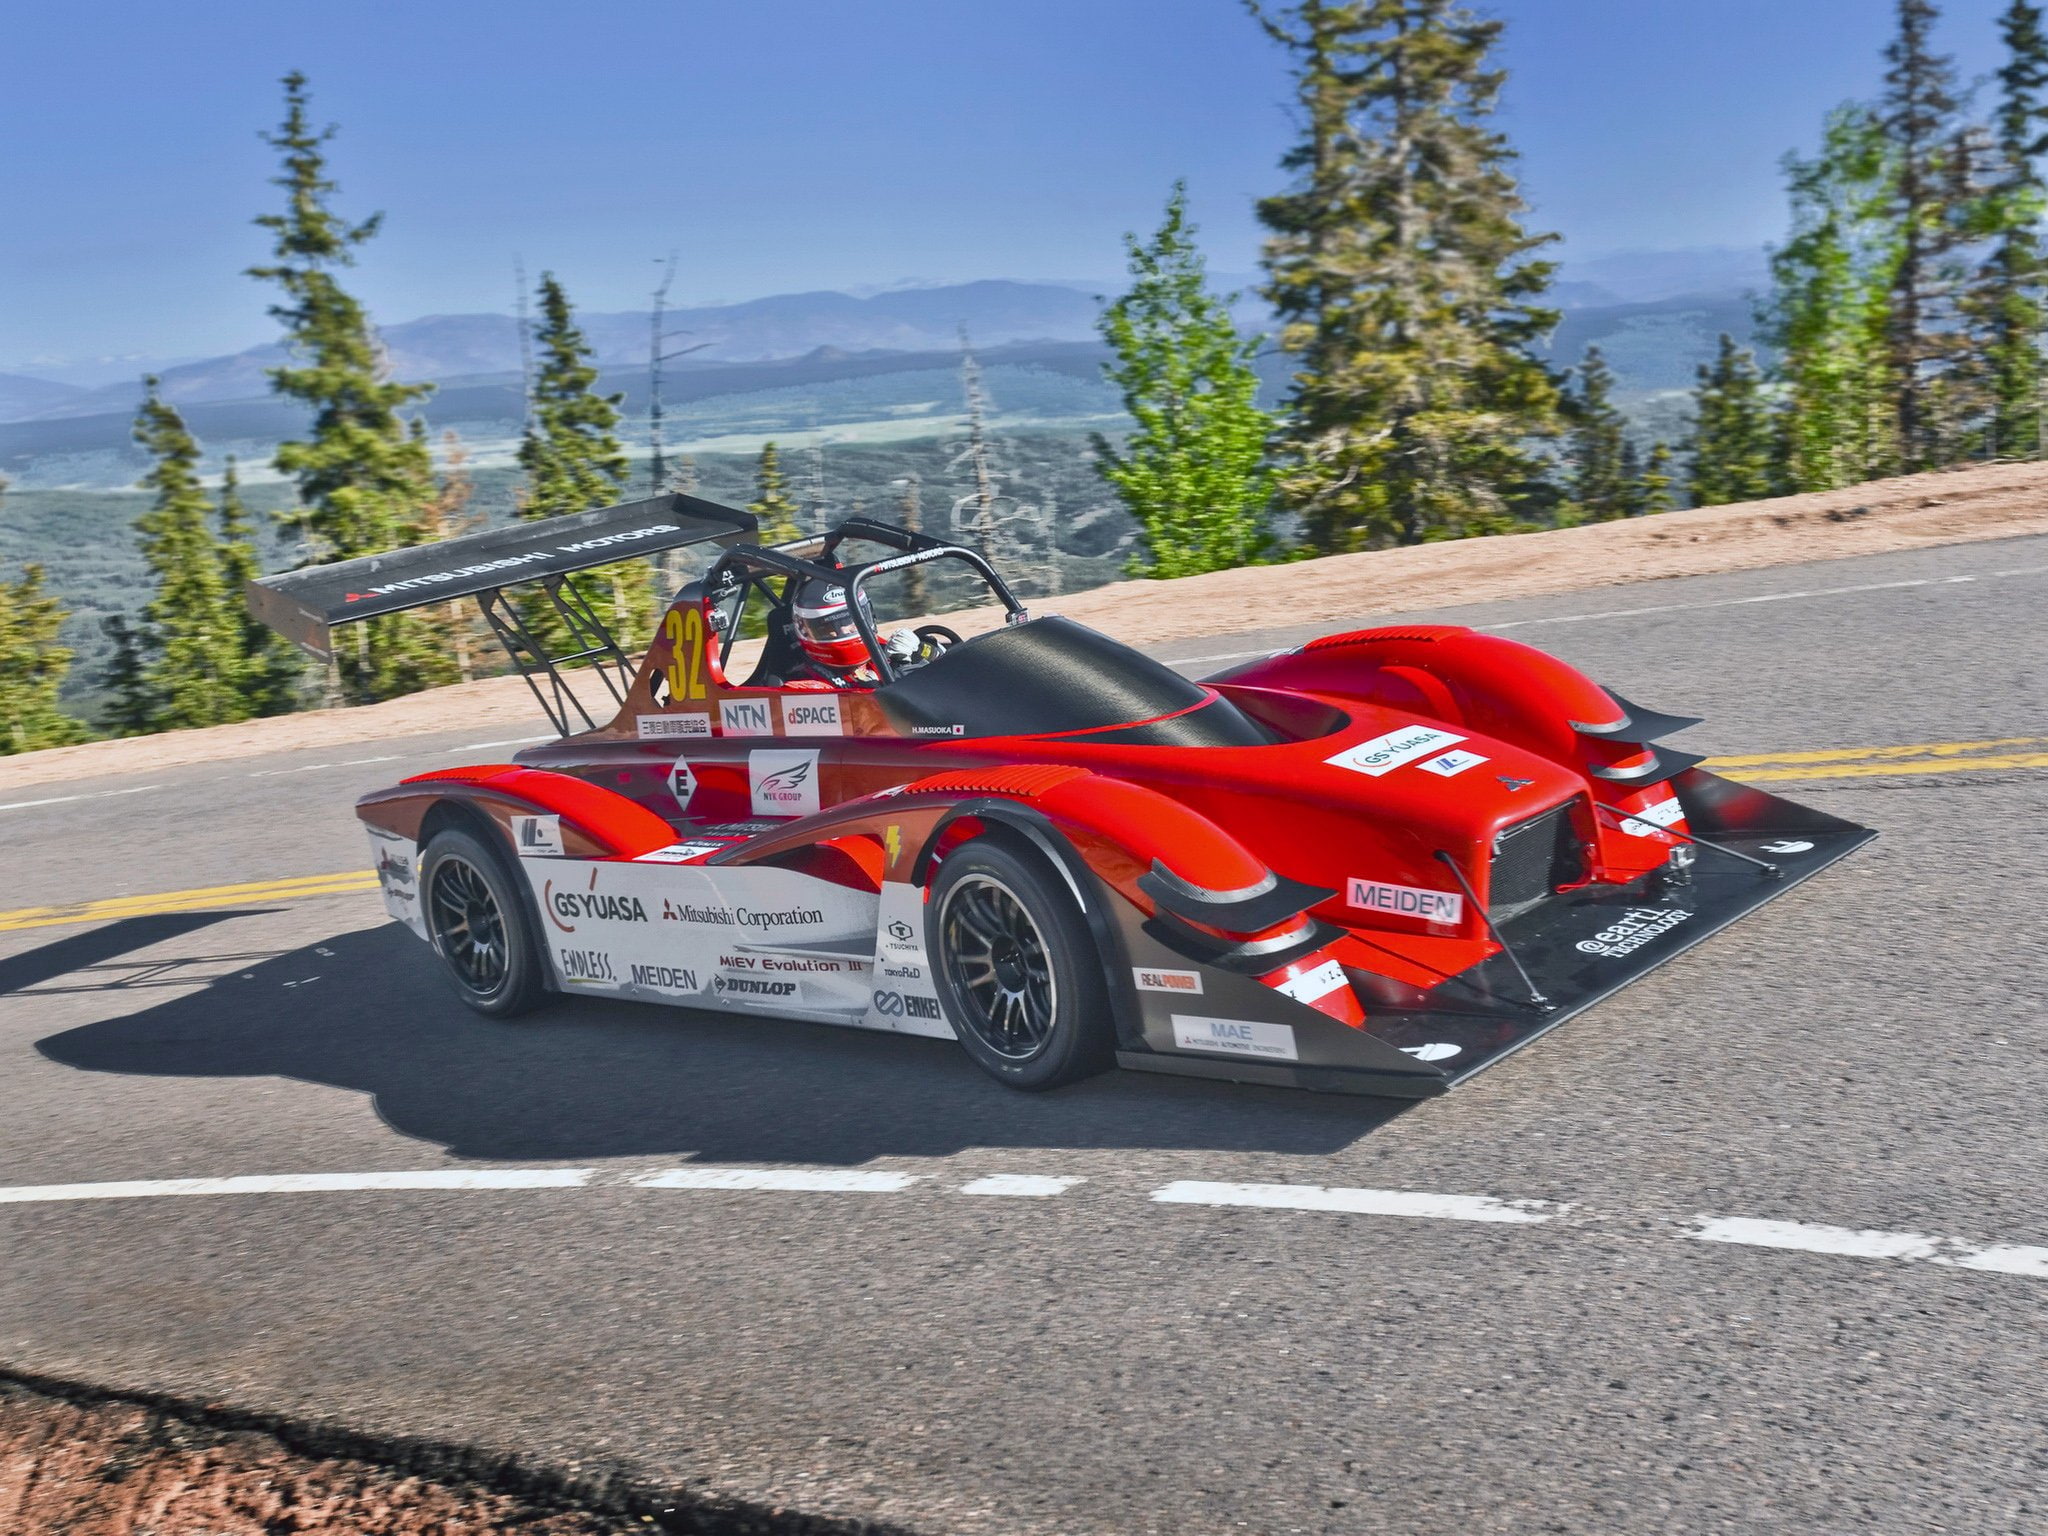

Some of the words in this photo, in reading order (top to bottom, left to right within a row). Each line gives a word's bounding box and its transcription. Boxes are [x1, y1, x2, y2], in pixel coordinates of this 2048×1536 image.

[368, 552, 555, 594] MITSUBISHI
[556, 525, 680, 552] MOTORS
[666, 608, 706, 702] 32
[724, 704, 767, 730] NTN
[788, 706, 837, 724] dSPACE
[675, 769, 689, 797] E
[763, 792, 778, 801] NYK
[778, 792, 802, 801] GROUP
[1354, 884, 1454, 918] MEIDEN
[677, 904, 736, 925] Mitsubishi
[736, 906, 824, 930] Corporation
[1601, 909, 1694, 958] TECHNOLOGY
[631, 964, 698, 990] MEIDEN
[720, 956, 755, 969] MiEV
[762, 959, 840, 972] Evolution
[848, 960, 863, 971] III
[727, 978, 796, 996] DUNLOP
[904, 994, 941, 1020] ENKEI
[1210, 1023, 1253, 1041] MAE
